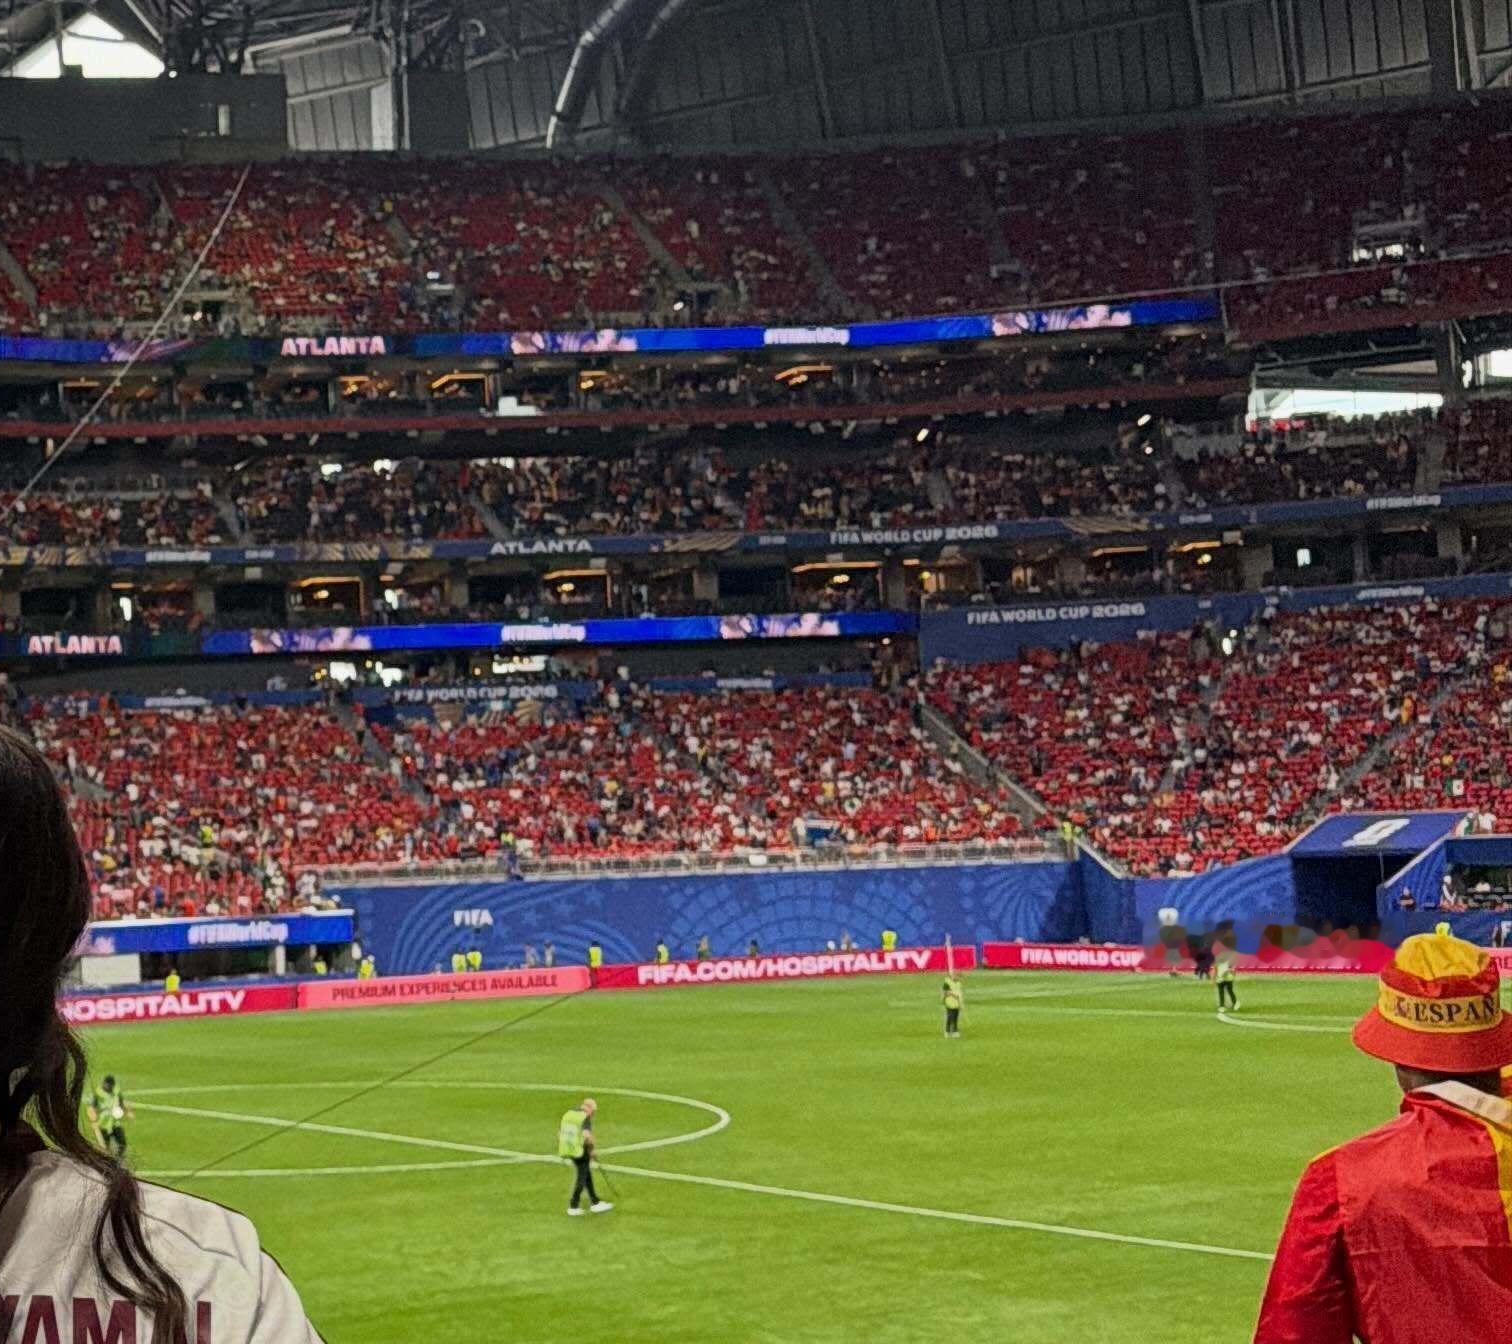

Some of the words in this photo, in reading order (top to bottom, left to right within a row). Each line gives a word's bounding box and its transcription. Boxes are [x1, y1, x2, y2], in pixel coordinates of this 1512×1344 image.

[281, 335, 386, 357] ATLANTA
[830, 531, 860, 545] FIFA
[862, 529, 911, 544] WORLD
[913, 528, 944, 543] CUP
[490, 539, 593, 556] ATLANTA
[967, 611, 1000, 625] FIFA
[1001, 608, 1057, 624] WORLD
[1059, 606, 1090, 621] CUP
[1092, 602, 1145, 618] 2026
[27, 634, 123, 655] ATLANTA
[479, 687, 508, 700] CUP
[453, 908, 494, 927] FIFA
[636, 949, 931, 984] FIFA.COM/HOSPITALITY
[1021, 947, 1053, 965] FIFA
[1054, 948, 1108, 966] WORLD
[332, 985, 396, 1001] PREMIUM
[490, 974, 558, 991] AVAILABLE
